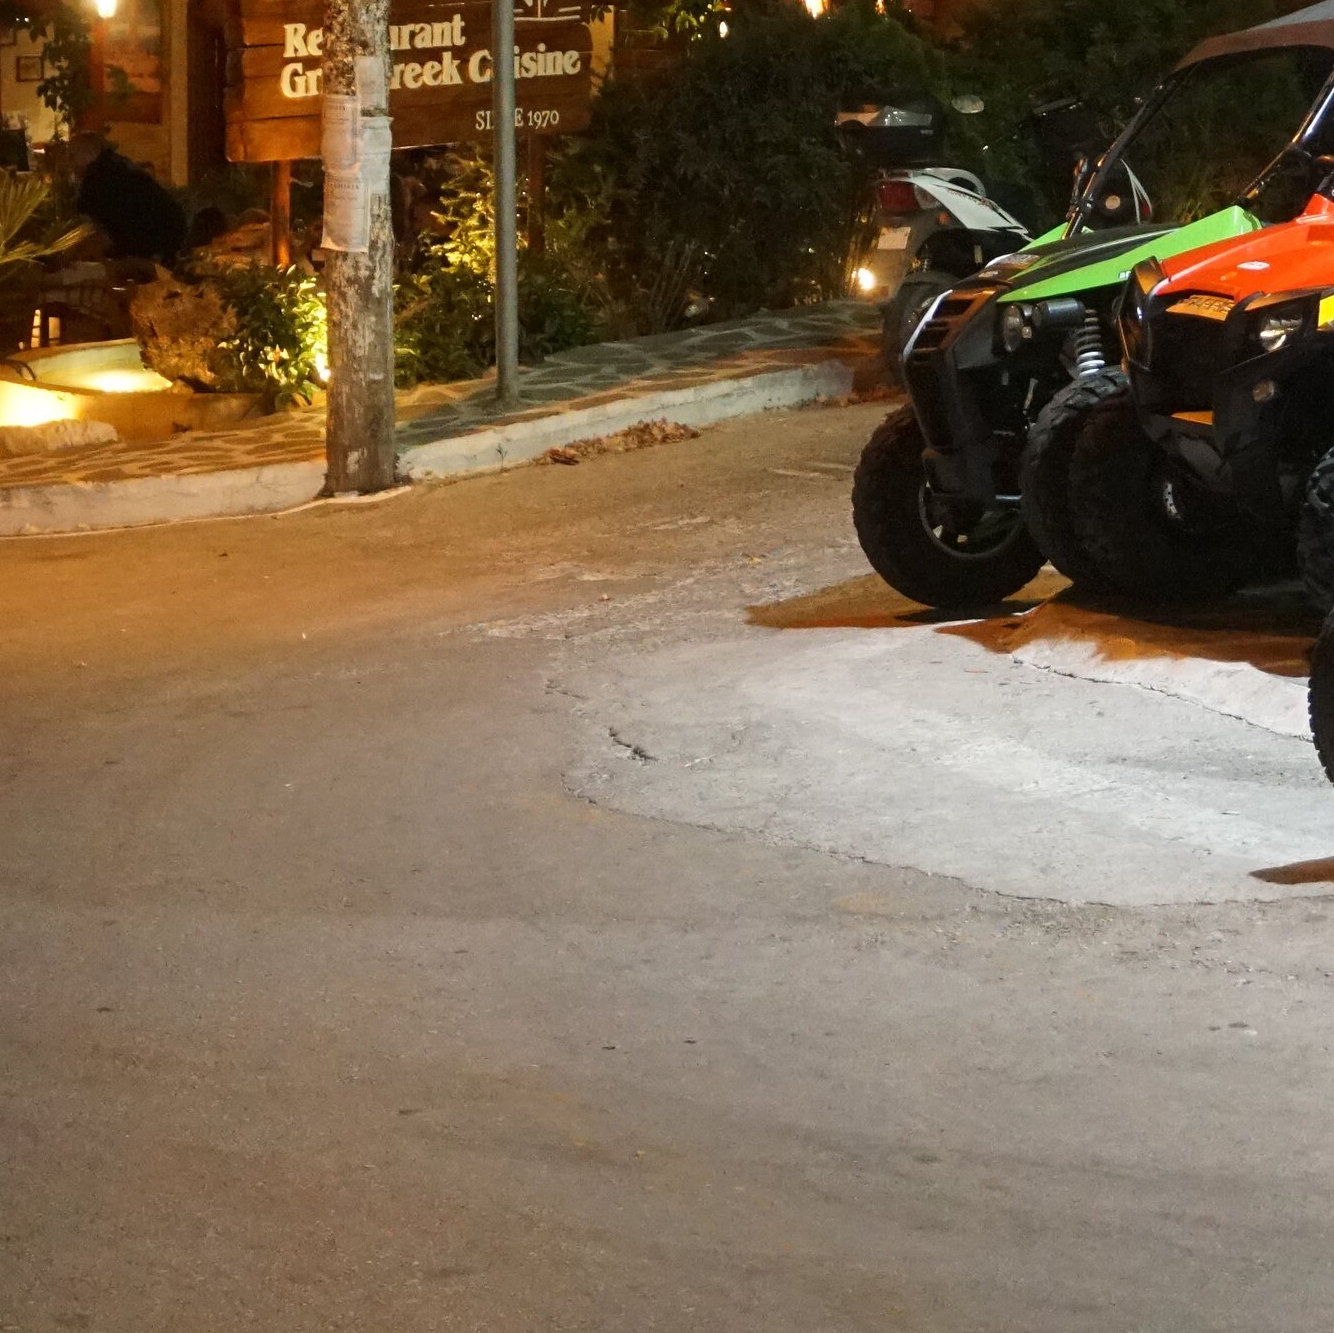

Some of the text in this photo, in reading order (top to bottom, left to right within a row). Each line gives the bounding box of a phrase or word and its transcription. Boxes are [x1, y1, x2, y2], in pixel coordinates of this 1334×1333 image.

[389, 43, 581, 90] reek Cisine
[475, 107, 560, 131] SIE 1970
